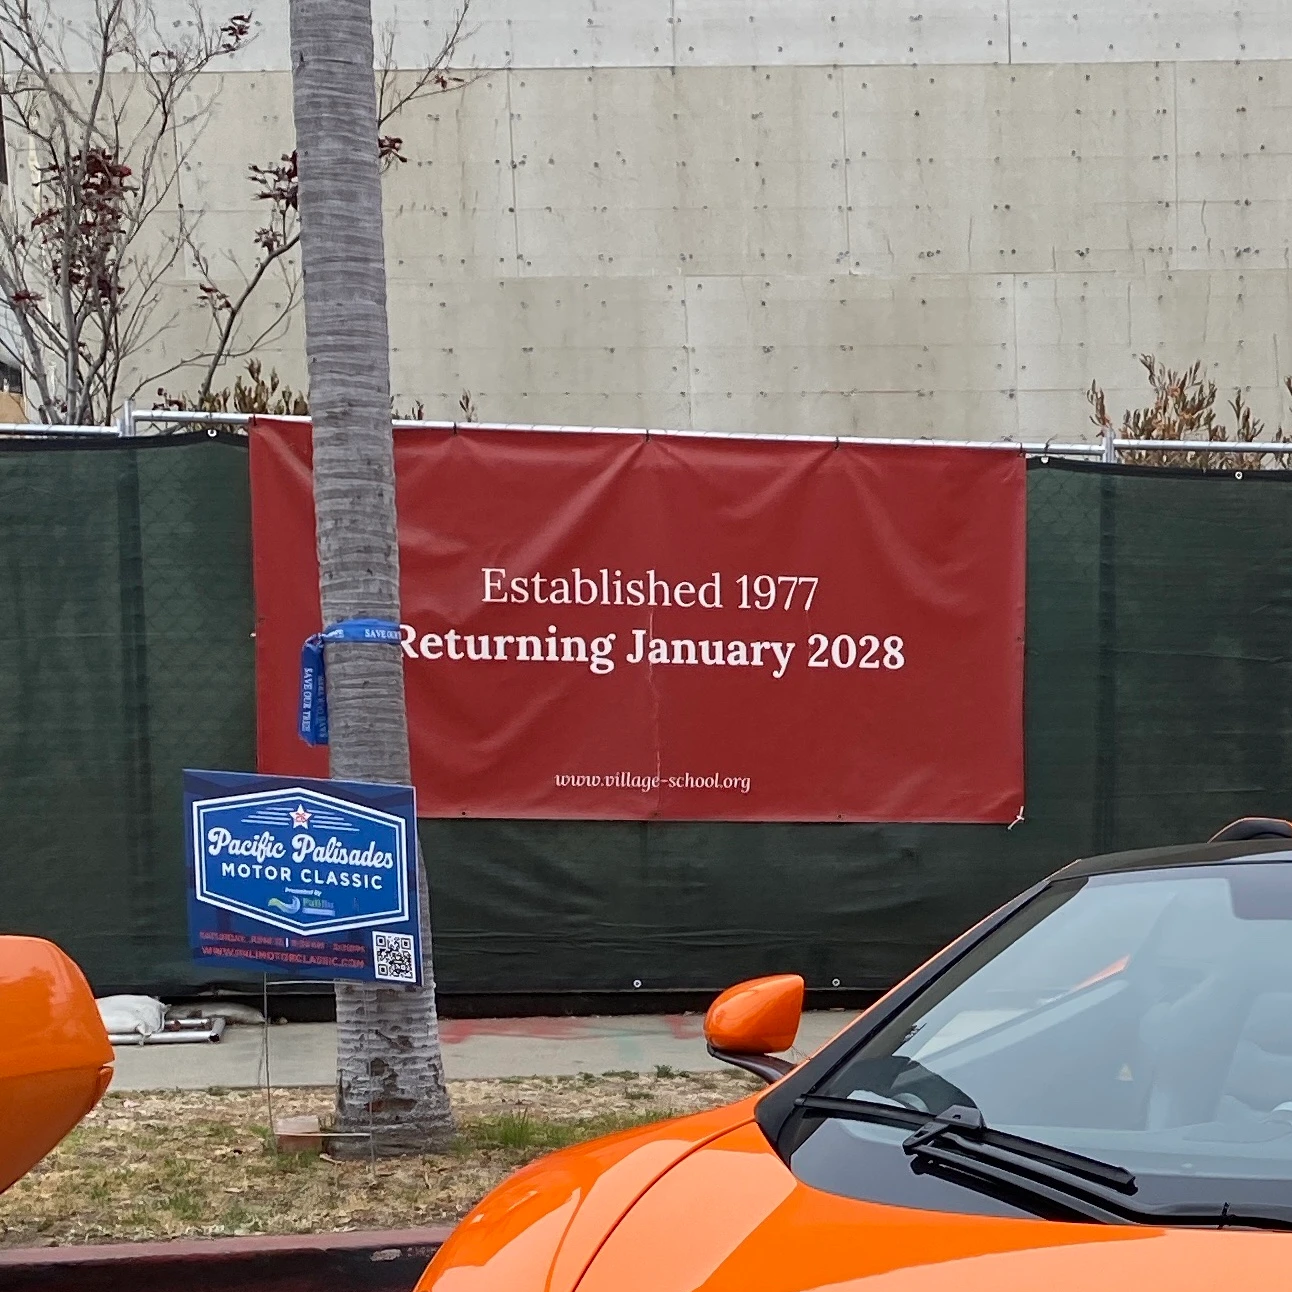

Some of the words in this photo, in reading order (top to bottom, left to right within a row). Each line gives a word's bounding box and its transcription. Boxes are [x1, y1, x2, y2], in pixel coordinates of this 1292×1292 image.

[481, 568, 723, 608] Established
[736, 574, 819, 611] 1977
[365, 629, 386, 639] SAVE
[399, 624, 616, 674] Returning
[626, 629, 795, 678] January
[807, 633, 905, 670] 2028
[304, 667, 313, 690] SAVE
[555, 772, 750, 793] www.village-school.org
[207, 827, 286, 863] Pacific
[291, 833, 394, 869] Palisades
[222, 863, 291, 882] MOTOR
[301, 868, 382, 890] CLASSIC
